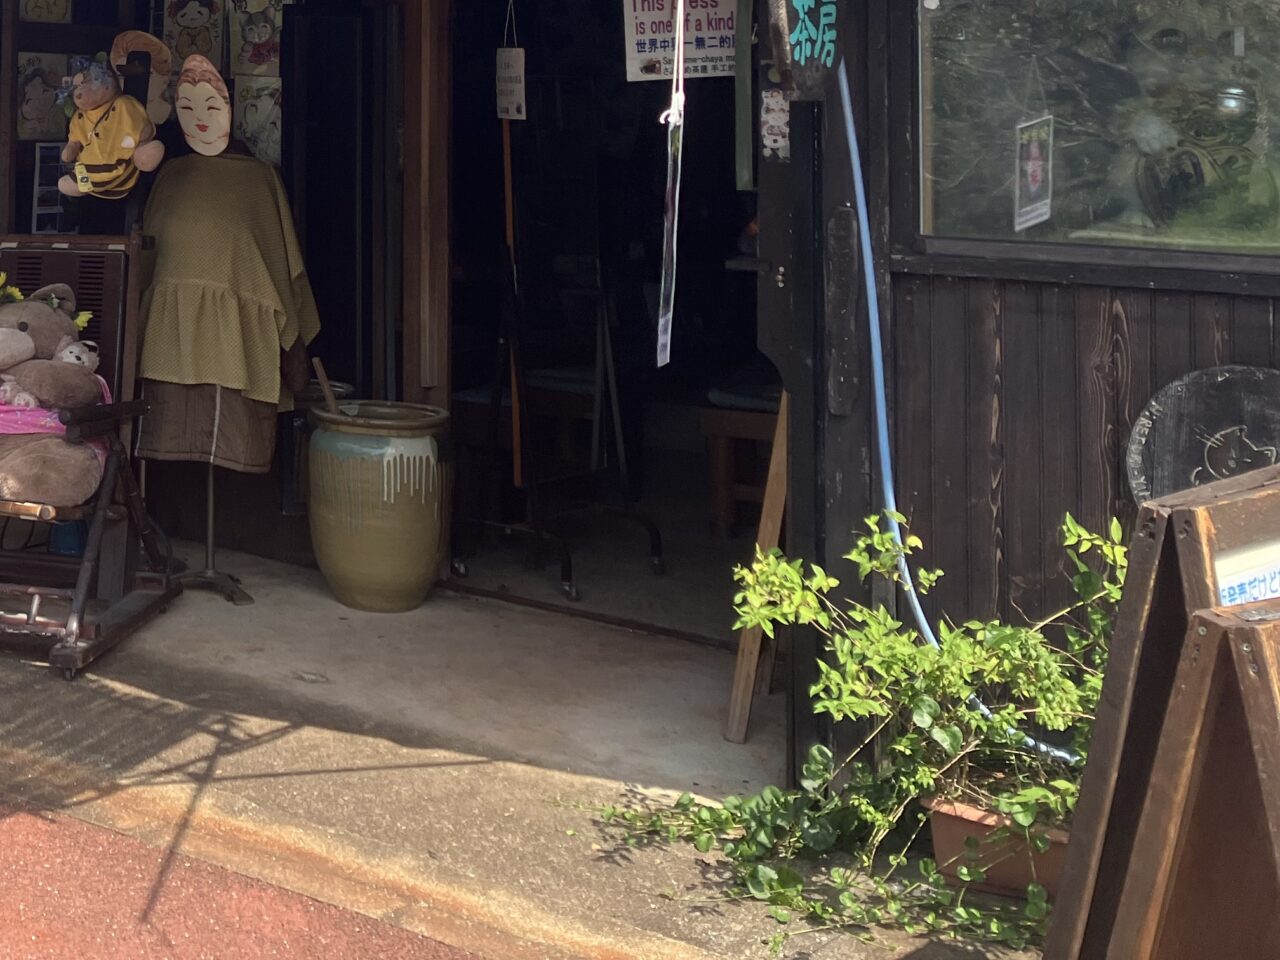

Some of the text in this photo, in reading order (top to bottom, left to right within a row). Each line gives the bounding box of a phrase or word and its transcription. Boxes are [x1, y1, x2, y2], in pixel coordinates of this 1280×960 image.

[635, 16, 646, 35] is
[651, 19, 673, 34] one
[695, 20, 703, 31] a
[707, 11, 734, 31] kind
